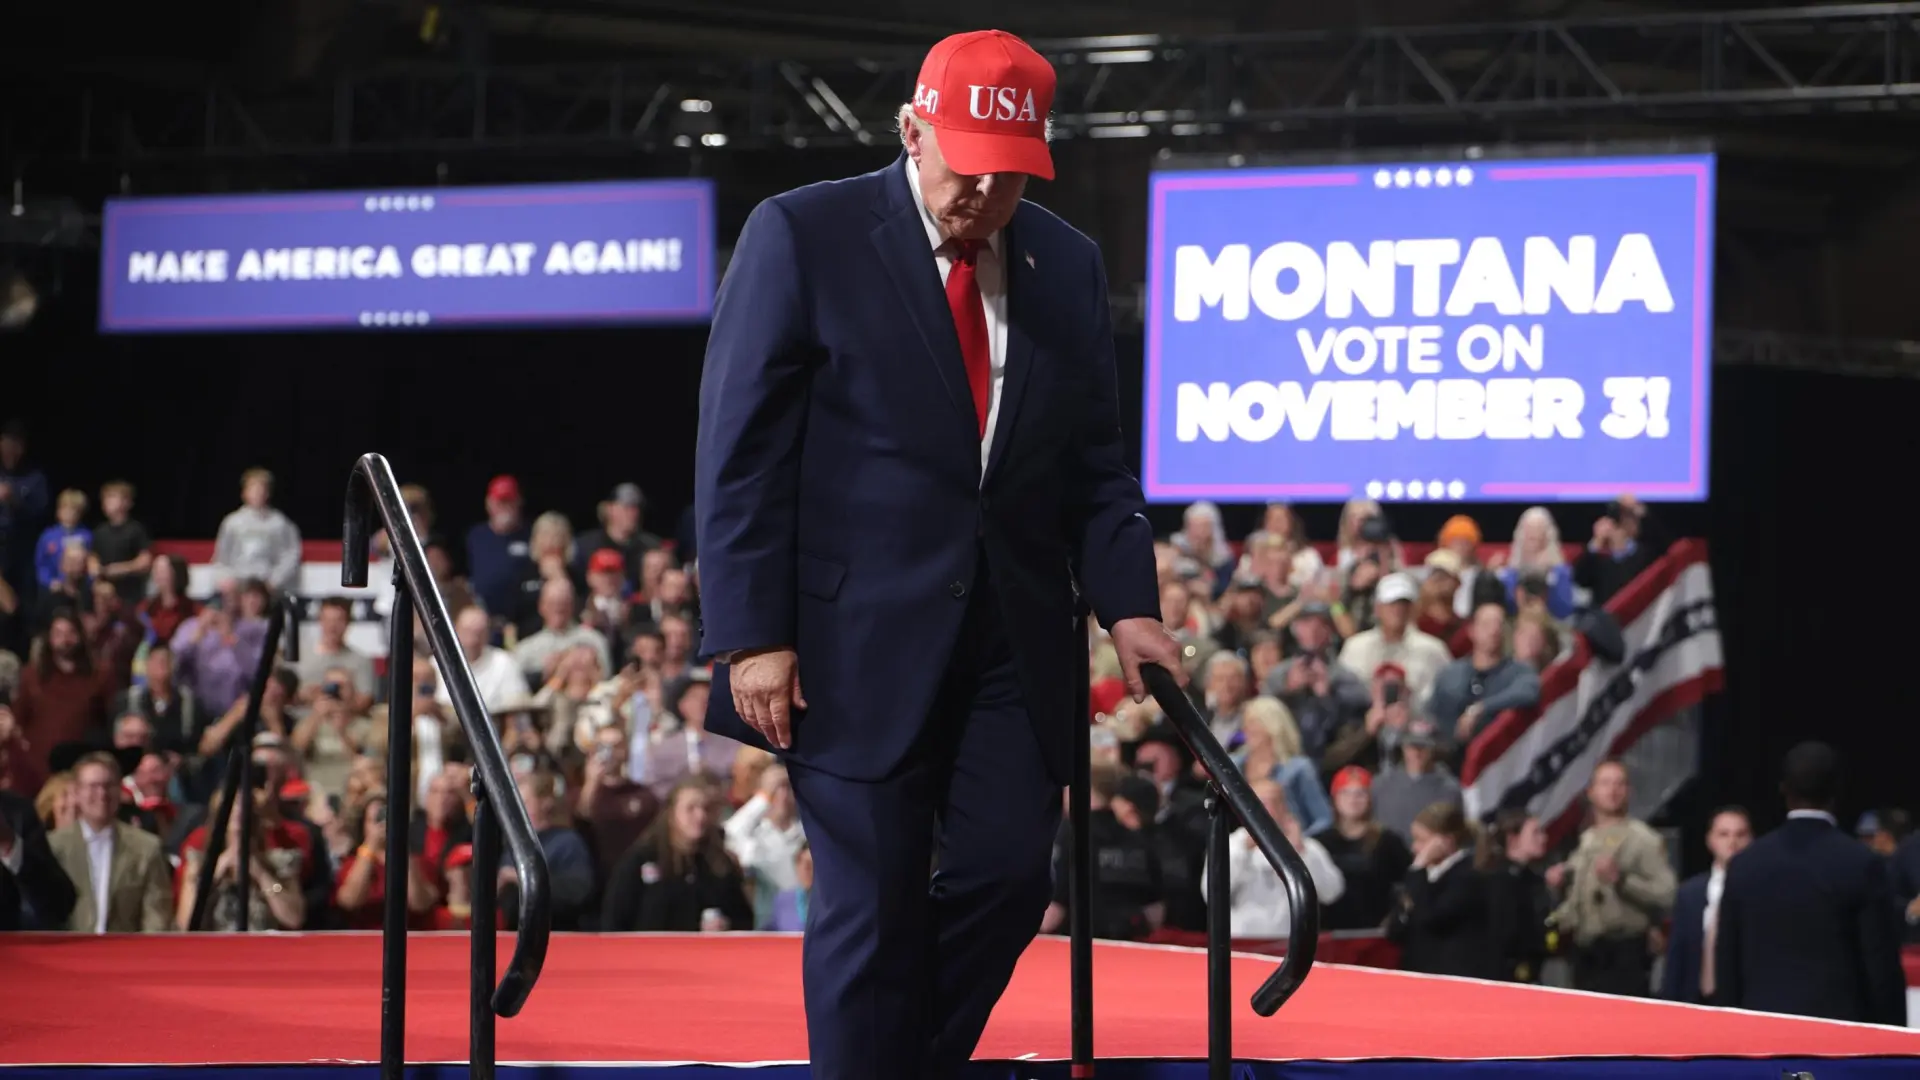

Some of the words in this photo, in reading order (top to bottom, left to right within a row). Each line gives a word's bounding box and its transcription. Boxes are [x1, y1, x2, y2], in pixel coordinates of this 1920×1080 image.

[968, 85, 1037, 121] USA
[128, 249, 229, 283] MAKE
[236, 245, 404, 282] AMERICA
[410, 242, 537, 279] GREAT
[543, 238, 683, 276] AGAIN!
[1173, 232, 1676, 321] MONTANA
[1295, 324, 1445, 376] VOTE
[1455, 323, 1545, 374] ON
[1175, 376, 1587, 443] NOVEMBER
[1598, 375, 1672, 440] 3!
